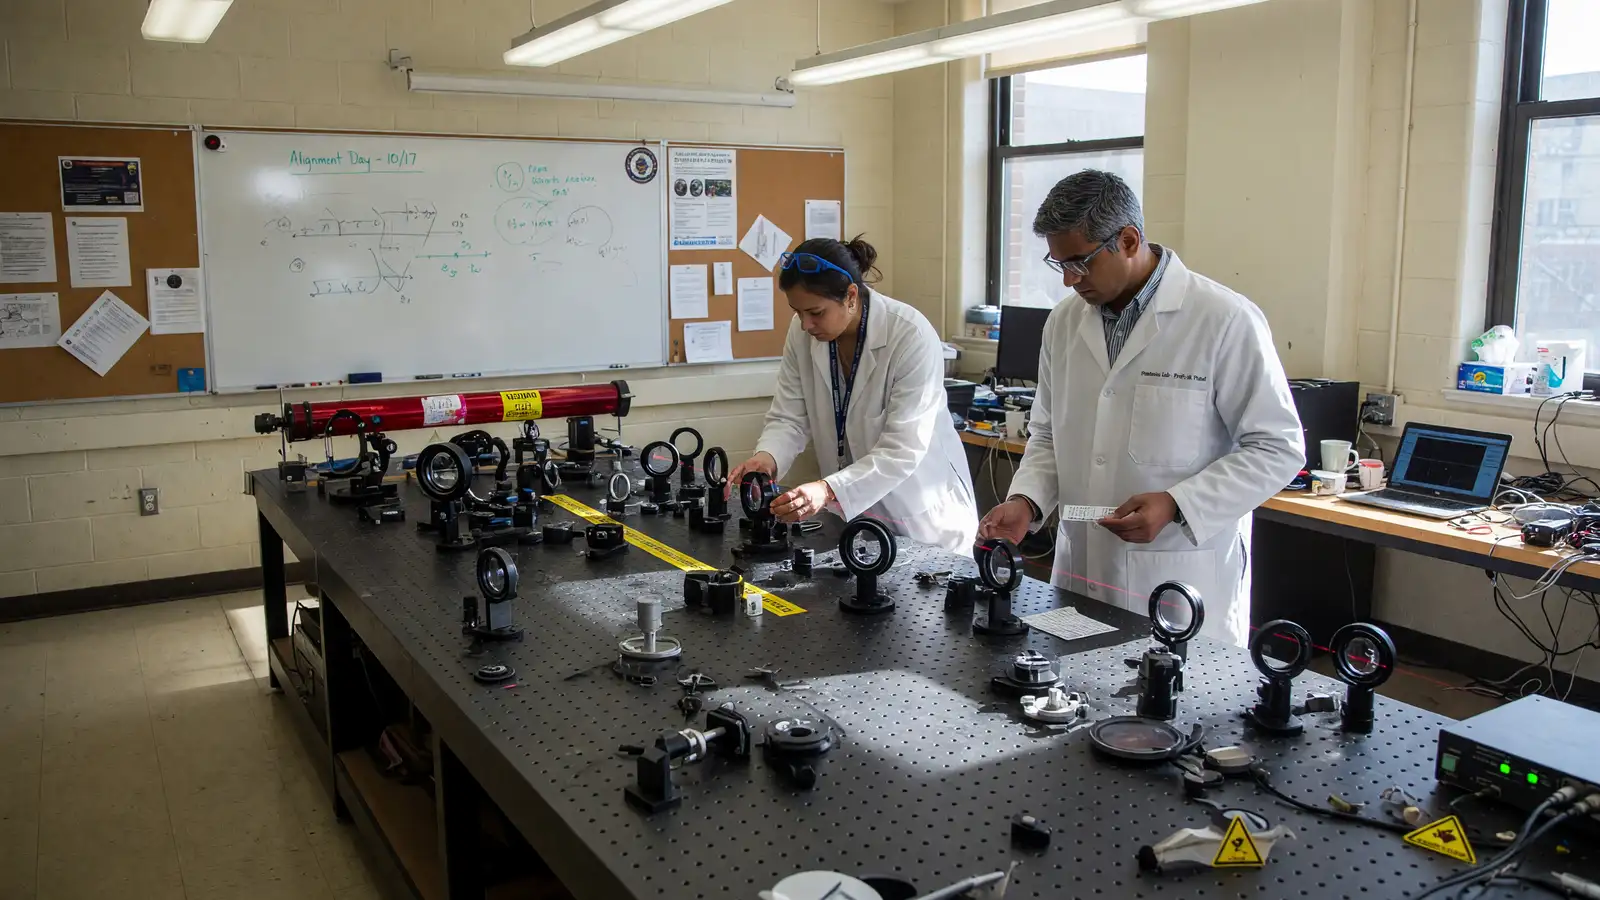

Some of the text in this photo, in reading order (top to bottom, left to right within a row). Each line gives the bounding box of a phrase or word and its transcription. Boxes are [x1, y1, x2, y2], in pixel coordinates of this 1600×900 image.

[289, 150, 344, 172] Alignment
[347, 150, 371, 173] Day
[387, 149, 417, 168] 10/17
